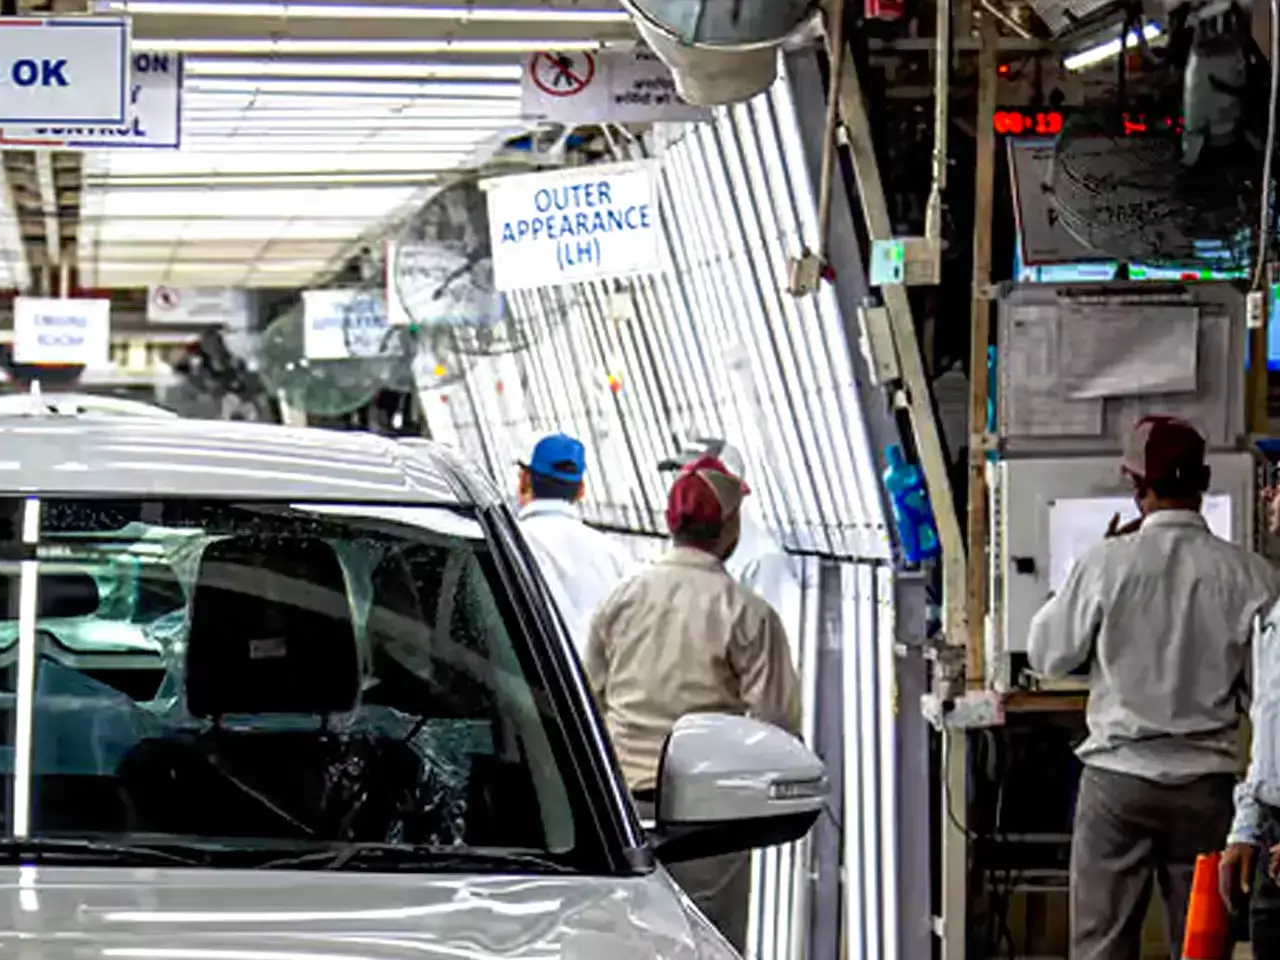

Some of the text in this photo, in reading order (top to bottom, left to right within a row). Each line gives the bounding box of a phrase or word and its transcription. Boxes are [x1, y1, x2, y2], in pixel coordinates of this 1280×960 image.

[11, 58, 70, 87] OK
[534, 180, 613, 213] OUTER
[501, 203, 651, 244] APPEARANCE
[556, 236, 602, 271] (LH)
